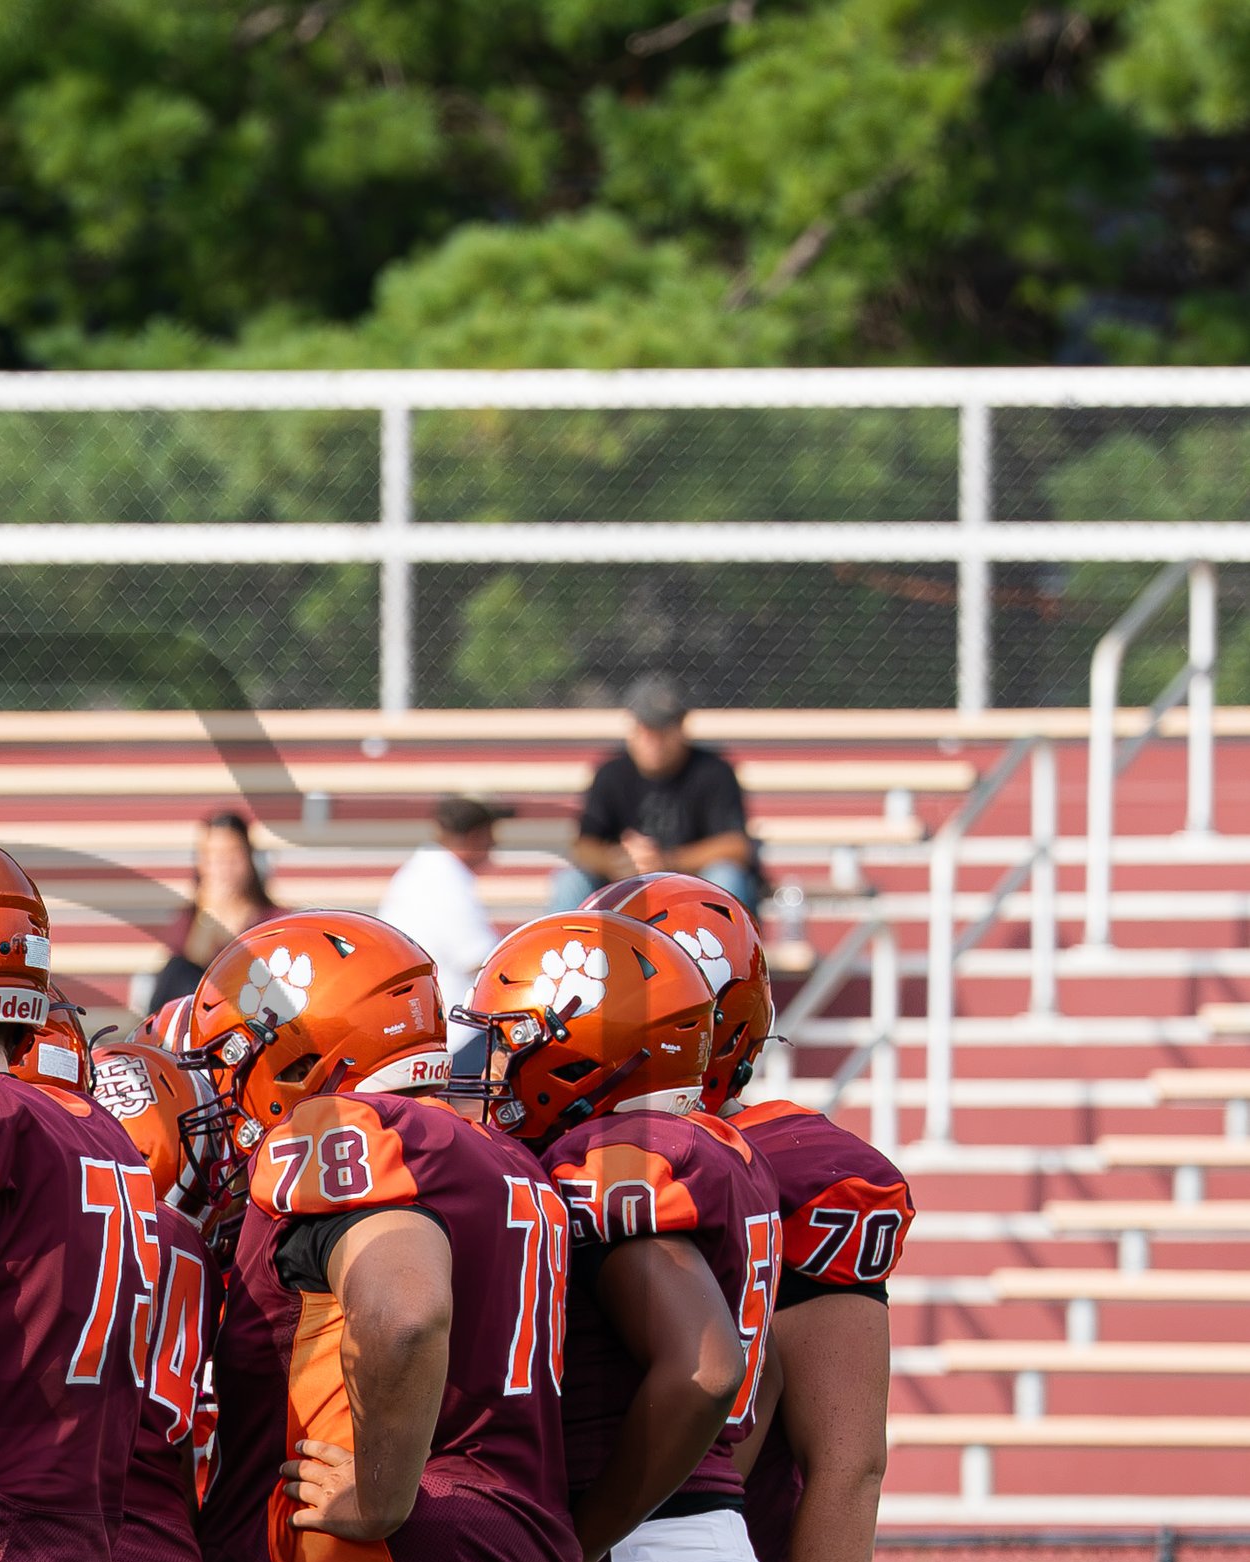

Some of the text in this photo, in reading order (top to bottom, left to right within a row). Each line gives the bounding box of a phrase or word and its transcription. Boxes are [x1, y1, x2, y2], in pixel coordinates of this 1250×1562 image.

[411, 1060, 452, 1083] Ridd
[268, 1124, 374, 1213] 78
[65, 1155, 161, 1388] 75
[502, 1174, 569, 1397] 78
[795, 1207, 903, 1281] 70
